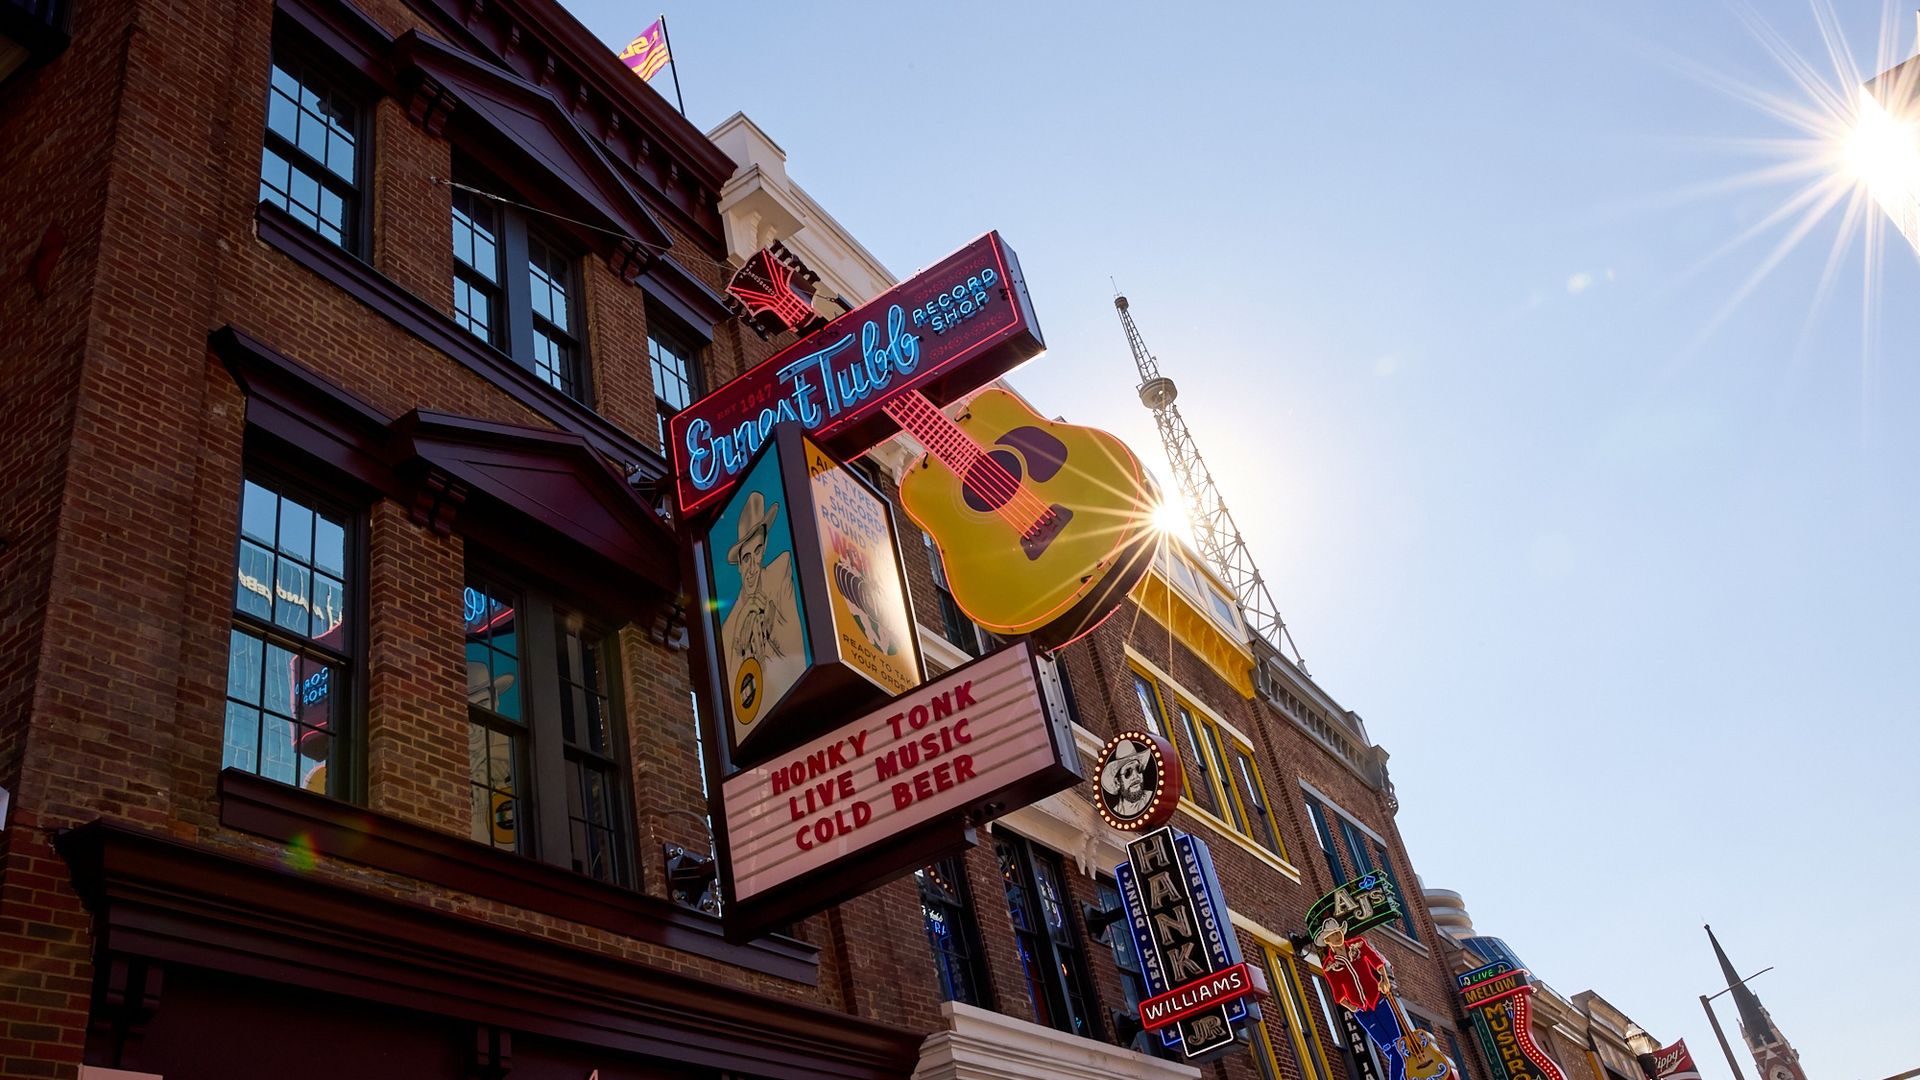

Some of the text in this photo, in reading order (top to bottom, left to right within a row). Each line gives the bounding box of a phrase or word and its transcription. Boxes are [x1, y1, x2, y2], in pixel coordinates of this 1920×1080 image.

[911, 267, 999, 328] RECORD
[930, 290, 991, 335] SHOP
[686, 303, 920, 491] Ernest Tubb
[740, 383, 772, 414] 1947
[811, 465, 828, 486] OF
[816, 456, 880, 516] ALL TYPES
[821, 505, 866, 556] ROUND
[830, 495, 880, 546] SHIPPED
[842, 633, 877, 661] READY
[880, 659, 892, 673] TO
[851, 649, 878, 673] YOUR
[771, 680, 977, 796] HONKY TONK
[789, 718, 973, 821] LIVE MUSIC
[796, 754, 978, 851] COLD BEER
[1124, 879, 1161, 980] EAT DRINK
[1134, 835, 1204, 982] HANK
[1184, 853, 1221, 955] BOOGIE BAR
[1145, 972, 1241, 1020] WILLIAMS
[1465, 976, 1516, 1004] MELLOW
[1472, 969, 1494, 982] LIVE
[1187, 1014, 1226, 1046] JR
[1343, 1010, 1365, 1054] ALAN
